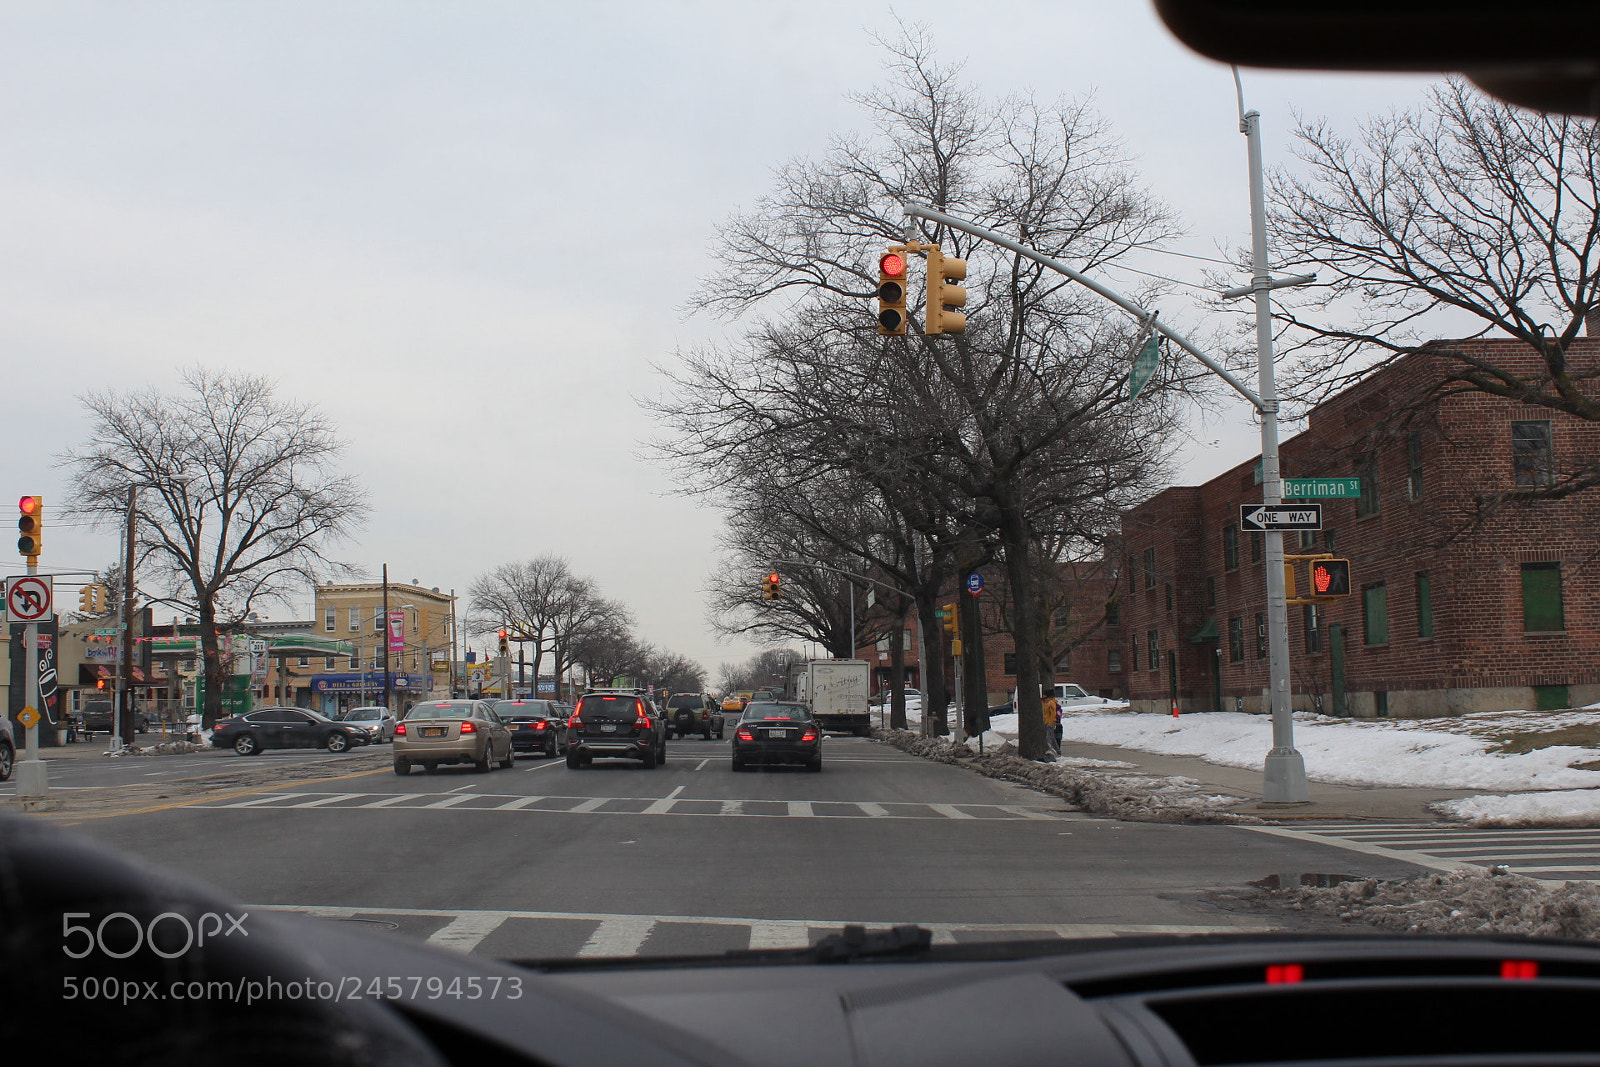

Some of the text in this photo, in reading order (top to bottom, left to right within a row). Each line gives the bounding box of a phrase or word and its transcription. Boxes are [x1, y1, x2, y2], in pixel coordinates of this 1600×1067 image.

[1285, 481, 1358, 497] Berriman St
[1256, 512, 1313, 523] ONE WAY
